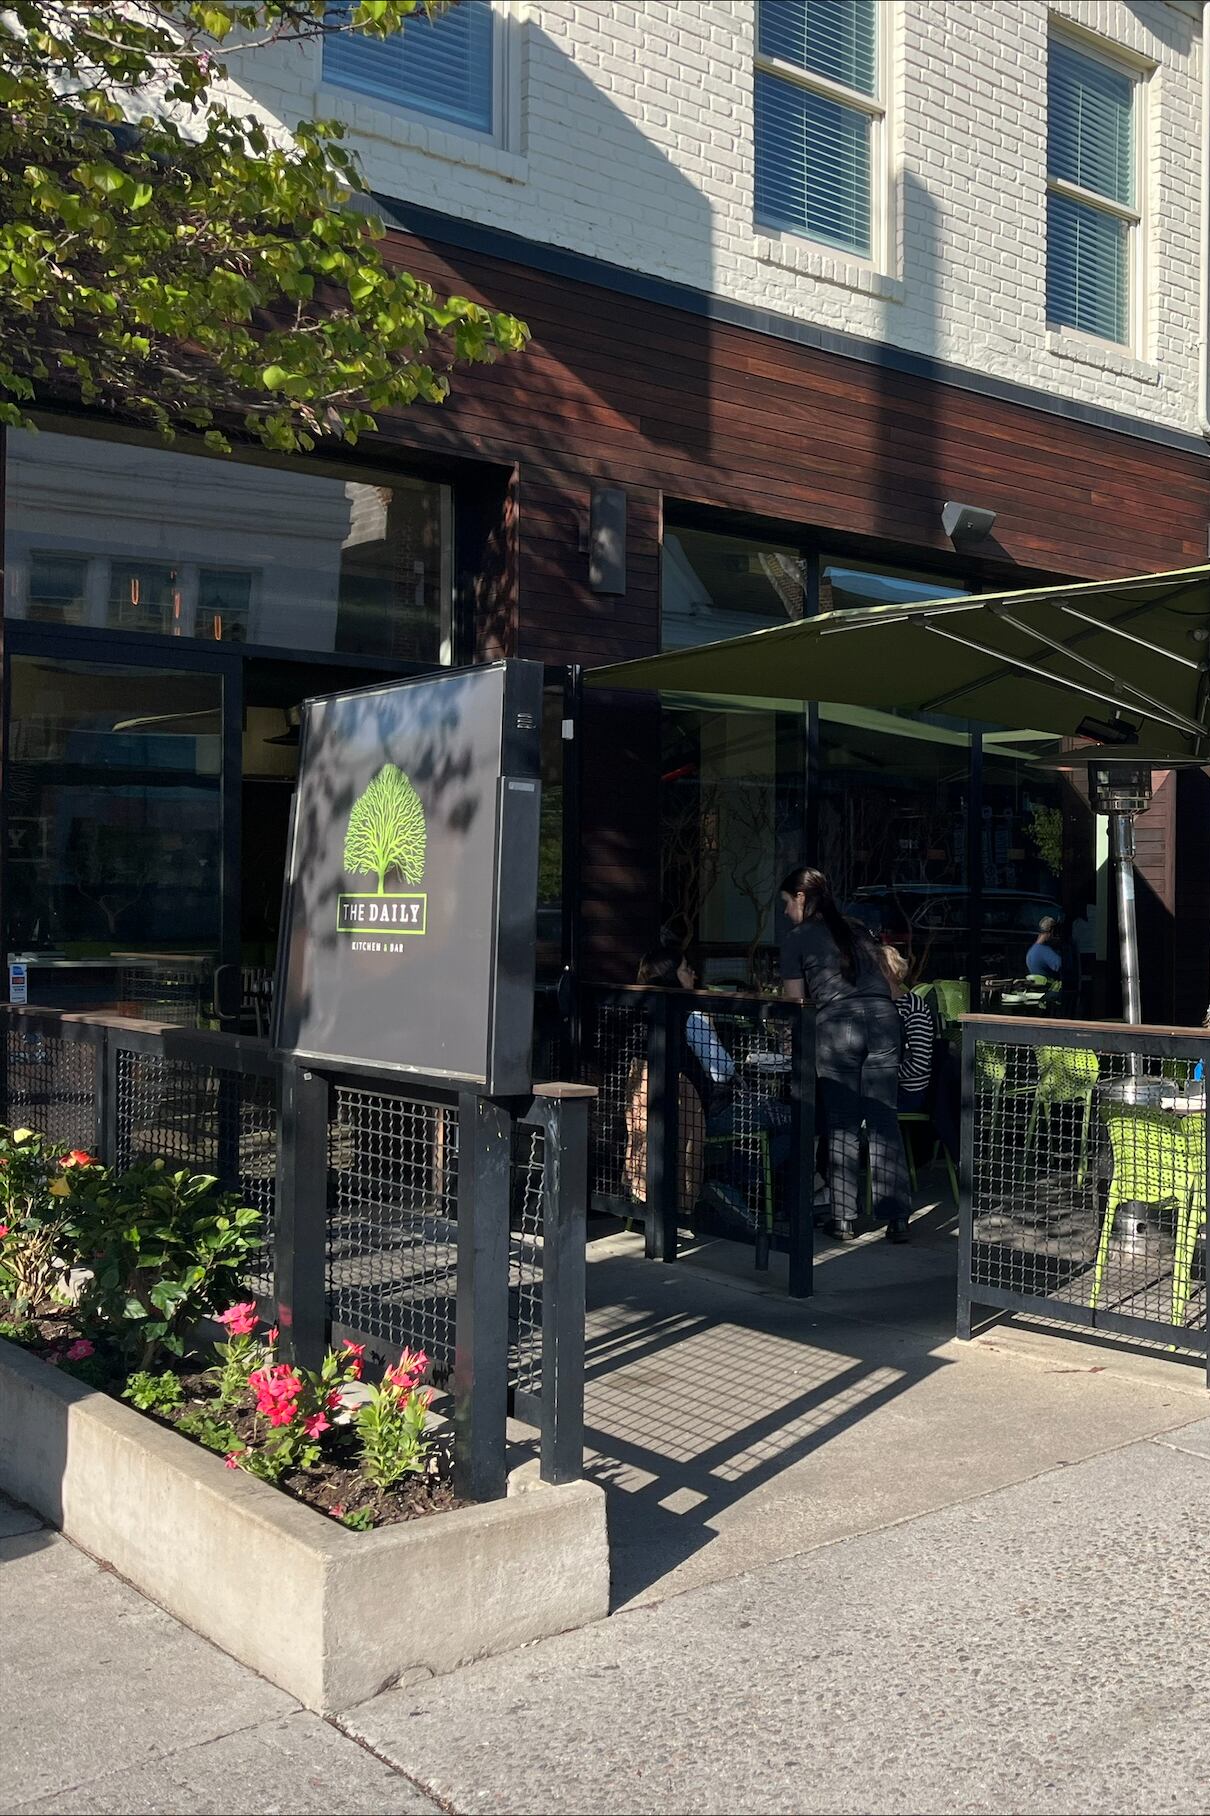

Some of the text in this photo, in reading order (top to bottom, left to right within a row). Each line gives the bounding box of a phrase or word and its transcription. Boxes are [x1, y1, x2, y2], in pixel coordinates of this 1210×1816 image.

[343, 903, 420, 922] THE DAILY
[351, 941, 381, 952] KITCHEN
[389, 943, 404, 952] BAR
